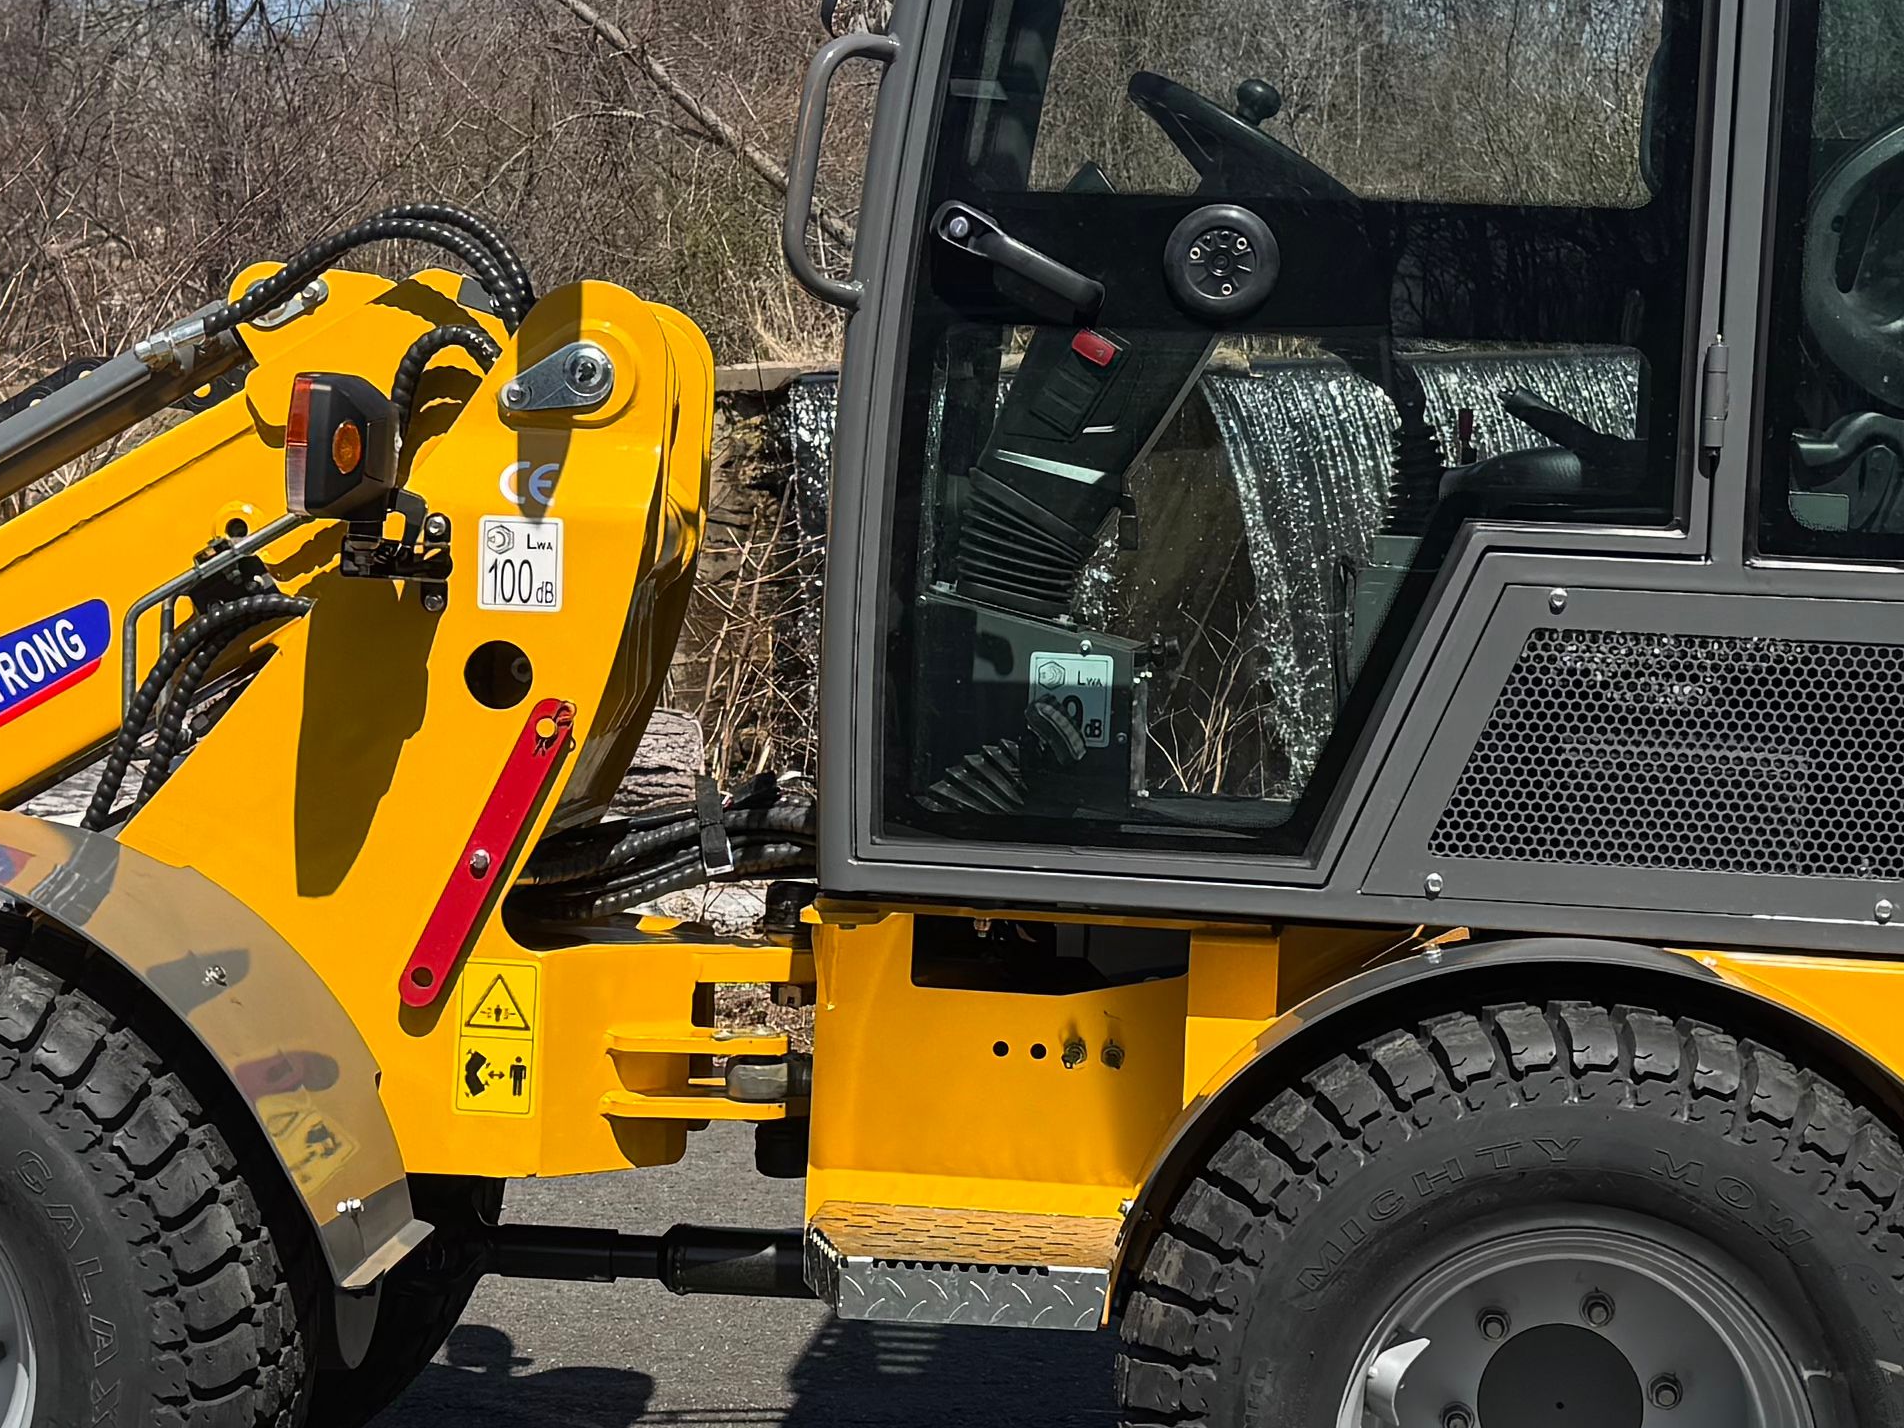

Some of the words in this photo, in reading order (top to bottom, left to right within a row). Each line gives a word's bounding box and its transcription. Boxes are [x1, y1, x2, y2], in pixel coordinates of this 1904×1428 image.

[499, 461, 559, 507] CE
[489, 558, 533, 603] 100
[536, 581, 554, 603] dB
[1084, 719, 1102, 738] dB
[1294, 1125, 1584, 1301] MIGHTY
[1646, 1143, 1815, 1260] MOW
